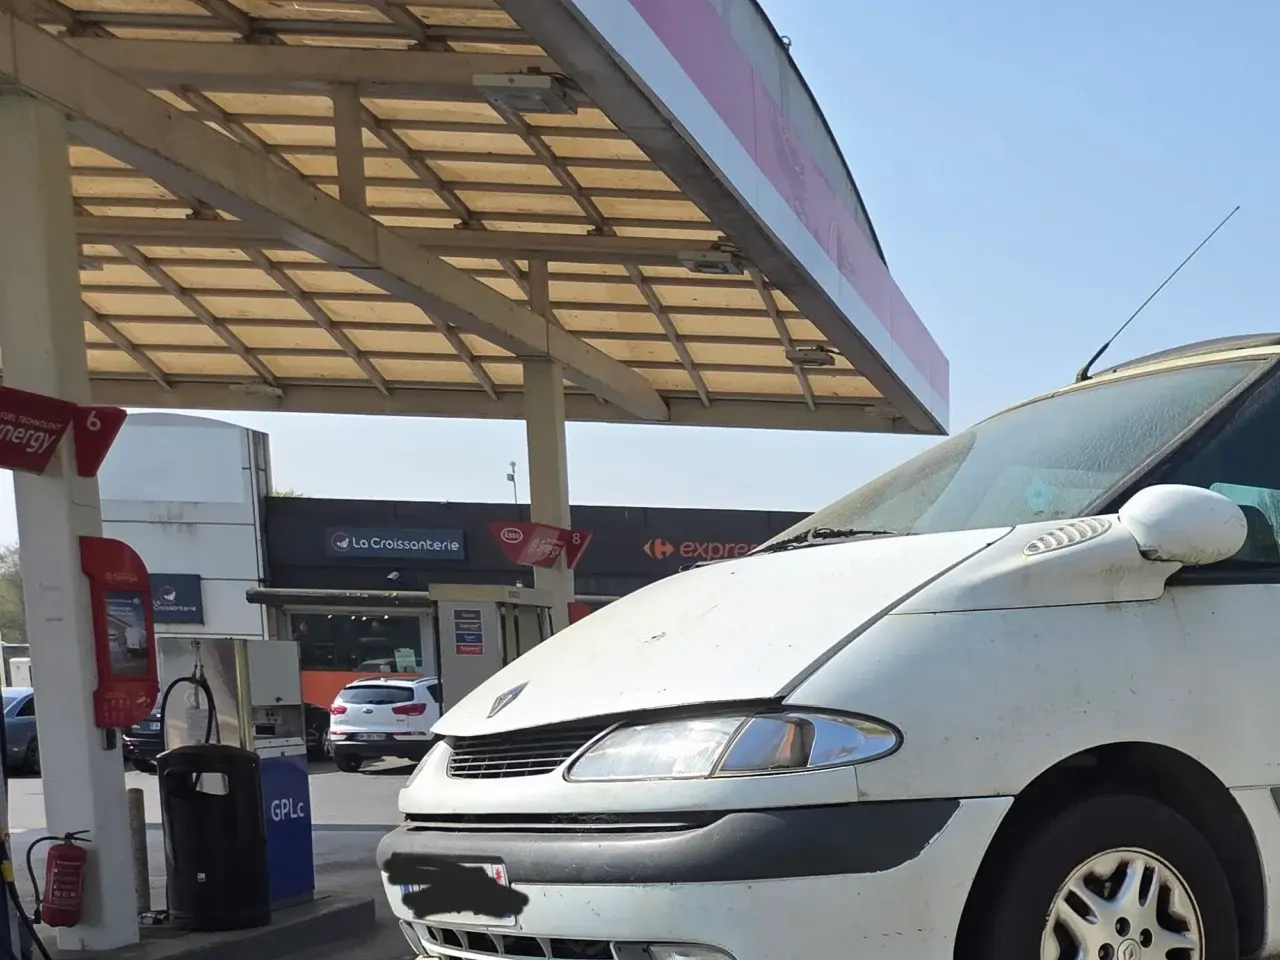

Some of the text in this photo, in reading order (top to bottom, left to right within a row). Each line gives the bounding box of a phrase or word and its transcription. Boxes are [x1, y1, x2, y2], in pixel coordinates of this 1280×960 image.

[86, 410, 101, 431] 6
[352, 537, 459, 551] La Croissanterie
[572, 532, 580, 544] 8
[271, 798, 305, 821] GPLc
